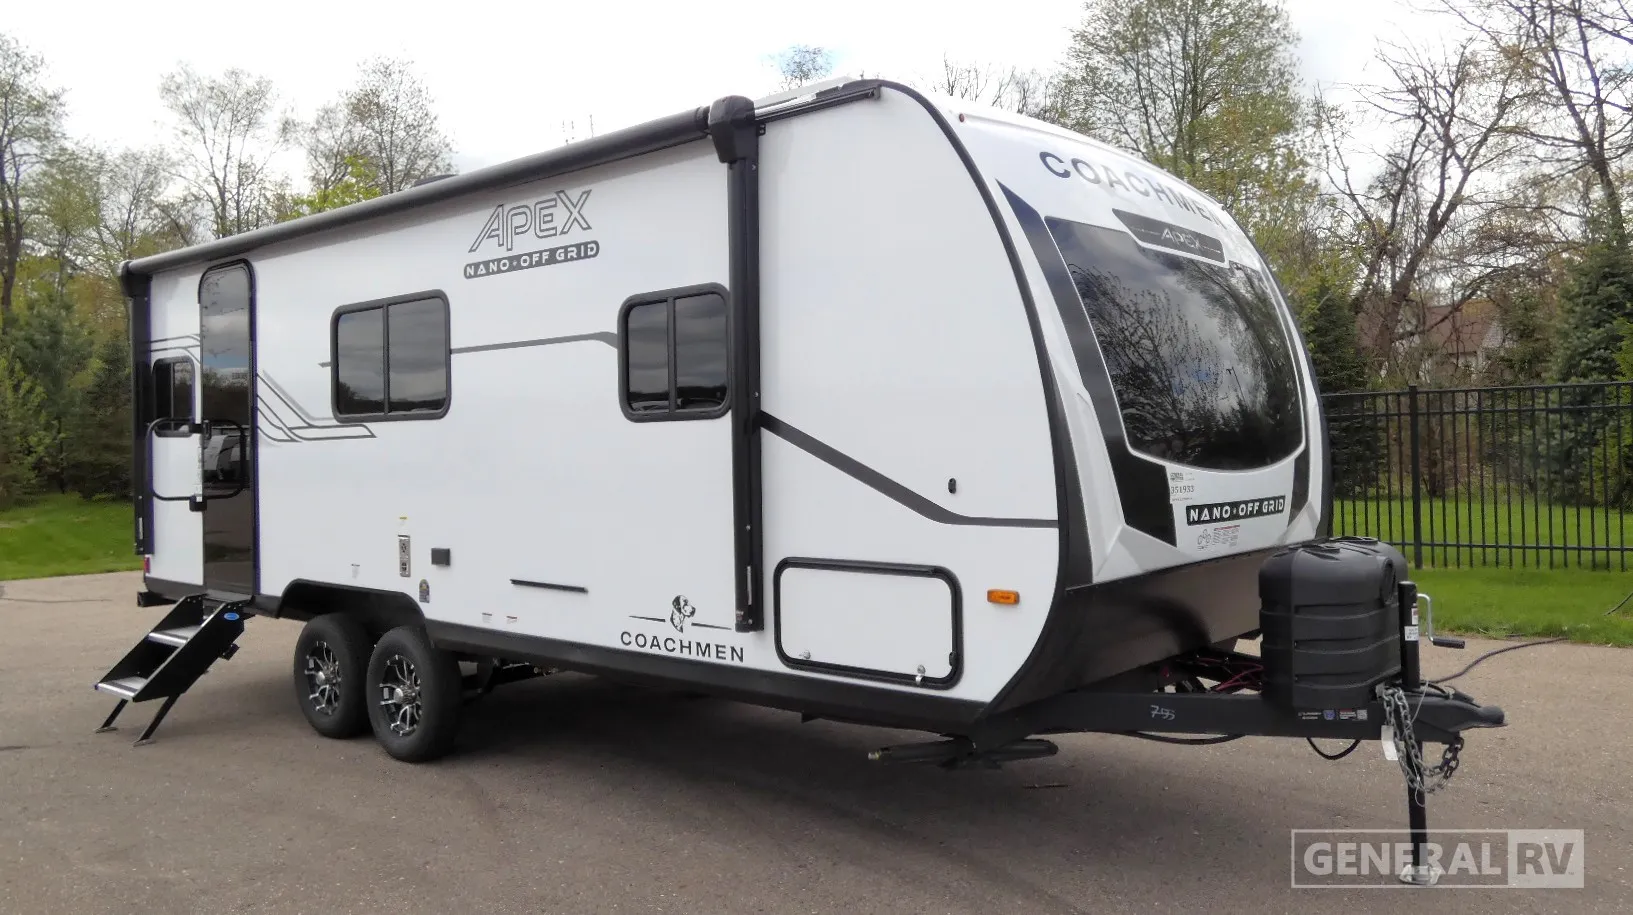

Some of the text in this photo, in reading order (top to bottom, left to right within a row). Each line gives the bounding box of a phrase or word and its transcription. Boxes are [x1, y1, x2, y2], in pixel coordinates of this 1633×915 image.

[1039, 151, 1227, 230] COACHMEN
[468, 189, 592, 253] APEX
[1161, 227, 1200, 248] APEX
[466, 243, 597, 276] NANO OFF GRID
[1170, 485, 1195, 495] 351933
[1190, 499, 1284, 522] NANO OFF GRID
[620, 631, 744, 662] COACHMEN
